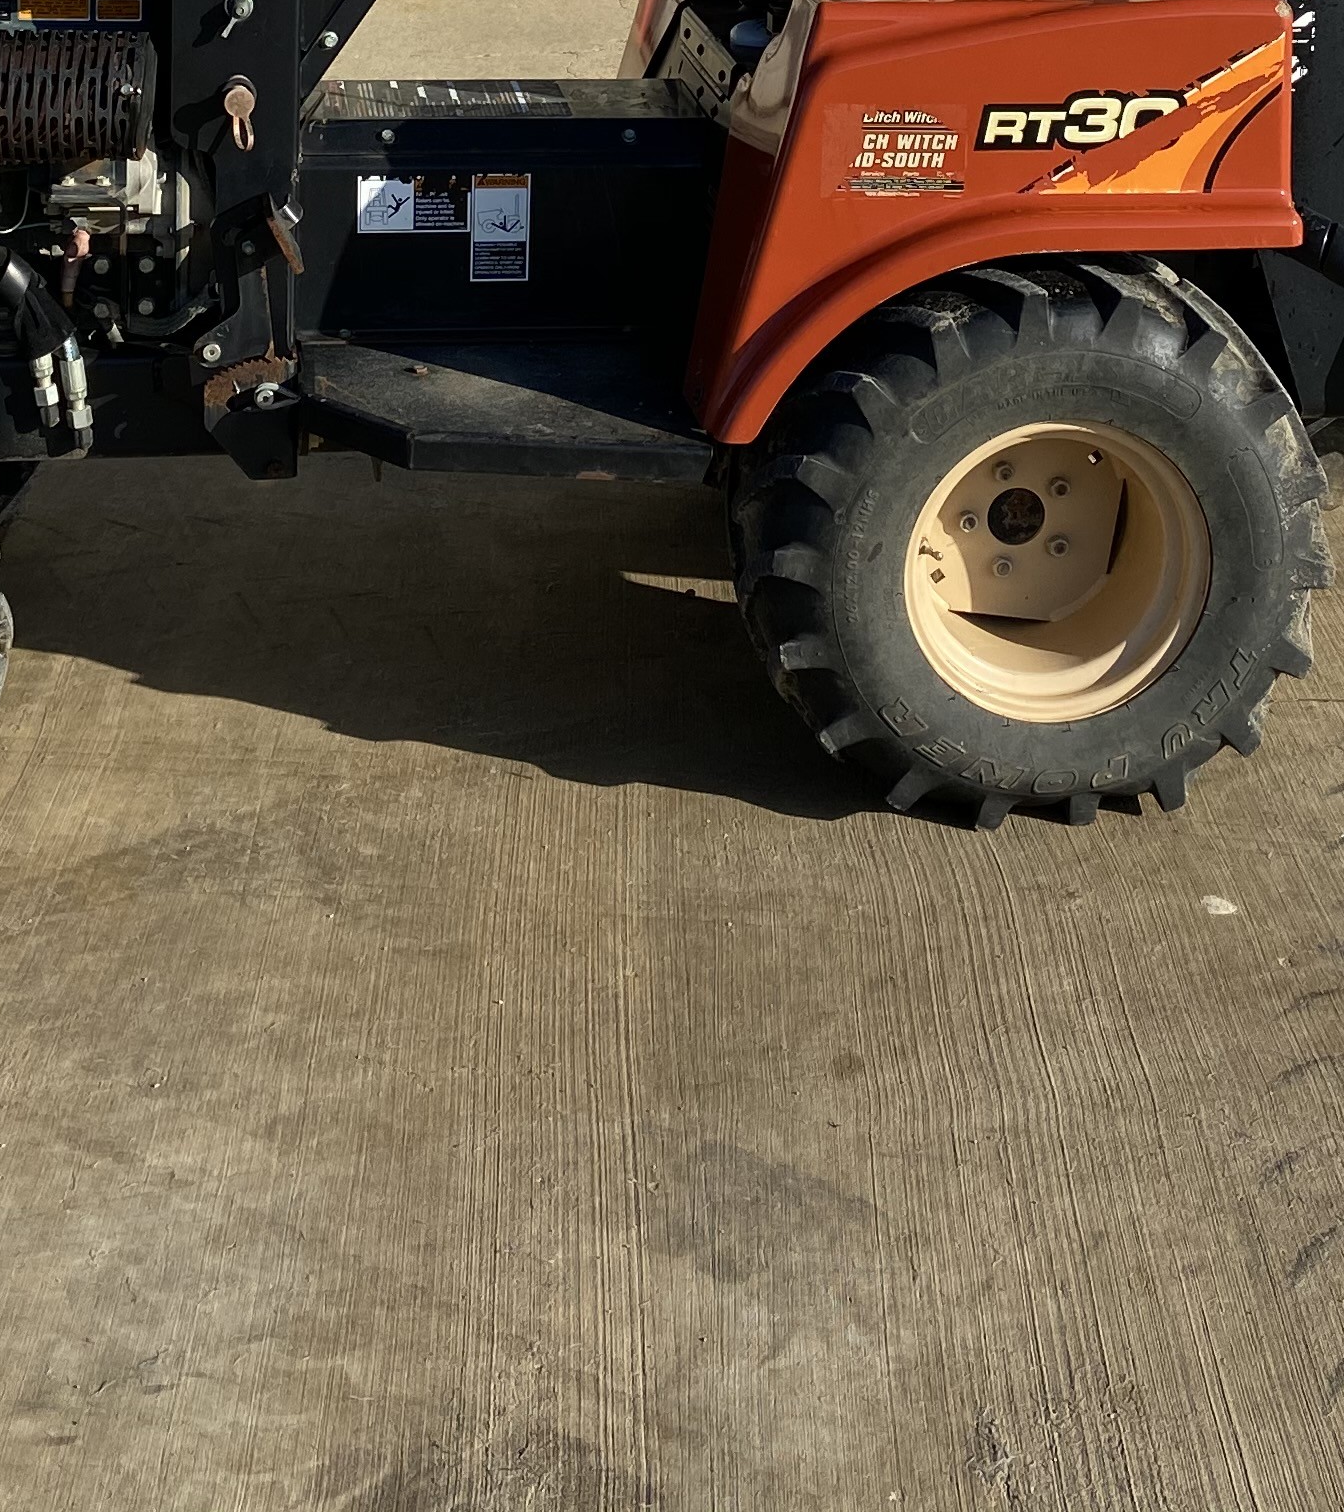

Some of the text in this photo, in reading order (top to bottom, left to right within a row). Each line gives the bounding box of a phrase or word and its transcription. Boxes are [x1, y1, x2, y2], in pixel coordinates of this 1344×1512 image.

[904, 111, 942, 124] Witc
[983, 96, 1180, 146] RT30
[897, 133, 959, 150] WITCH
[849, 152, 946, 168] ID-SOUTH
[484, 177, 526, 186] WARNING
[877, 646, 1257, 795] TRU POWER
